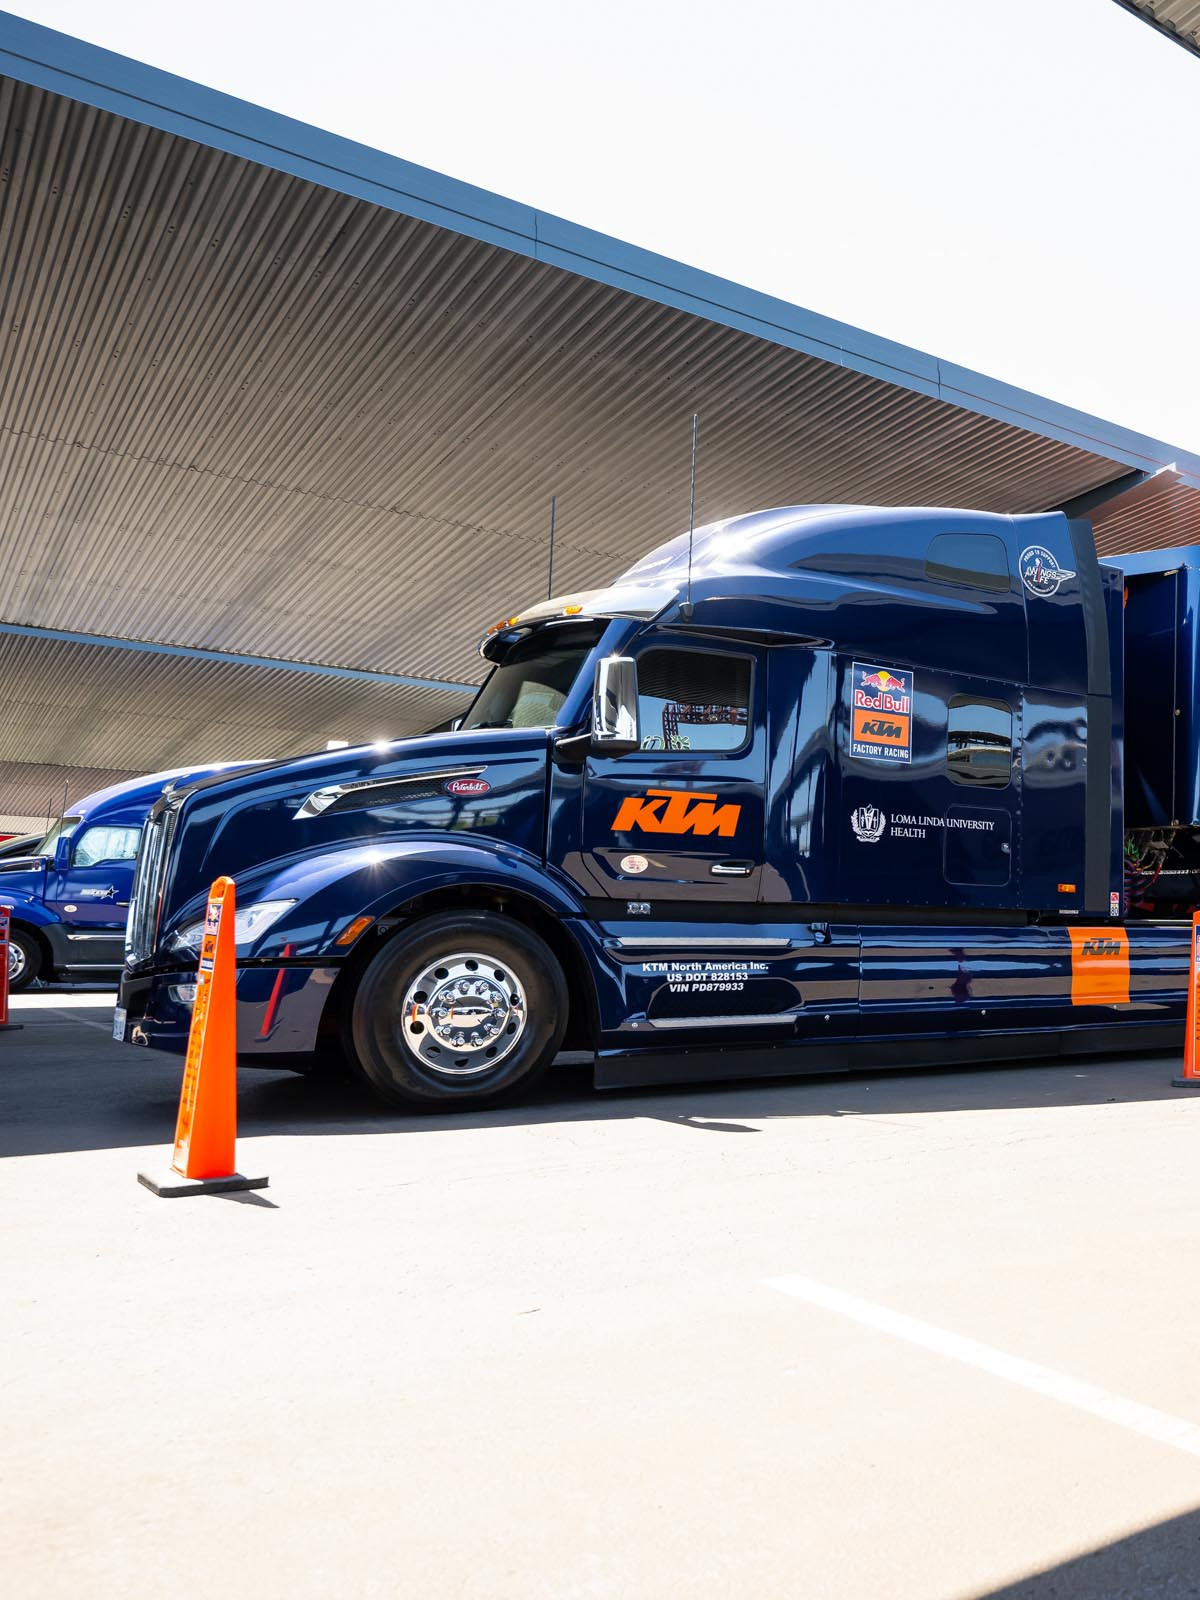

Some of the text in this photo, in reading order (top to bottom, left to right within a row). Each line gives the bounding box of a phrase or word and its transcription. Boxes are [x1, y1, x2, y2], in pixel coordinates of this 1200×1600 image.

[854, 689, 910, 714] Red Bull
[861, 719, 902, 738] KTM
[853, 743, 909, 759] FACTORY RACING
[452, 782, 486, 791] Peterbilt
[610, 789, 742, 837] KTM
[891, 814, 995, 831] LOMA LINDA UNIVERSITY
[891, 827, 926, 839] HEALTH
[1081, 937, 1120, 955] KTM
[643, 962, 769, 971] KTM North America Inc.
[667, 972, 748, 982] US DOT 828153
[669, 983, 744, 992] VIN PD879933
